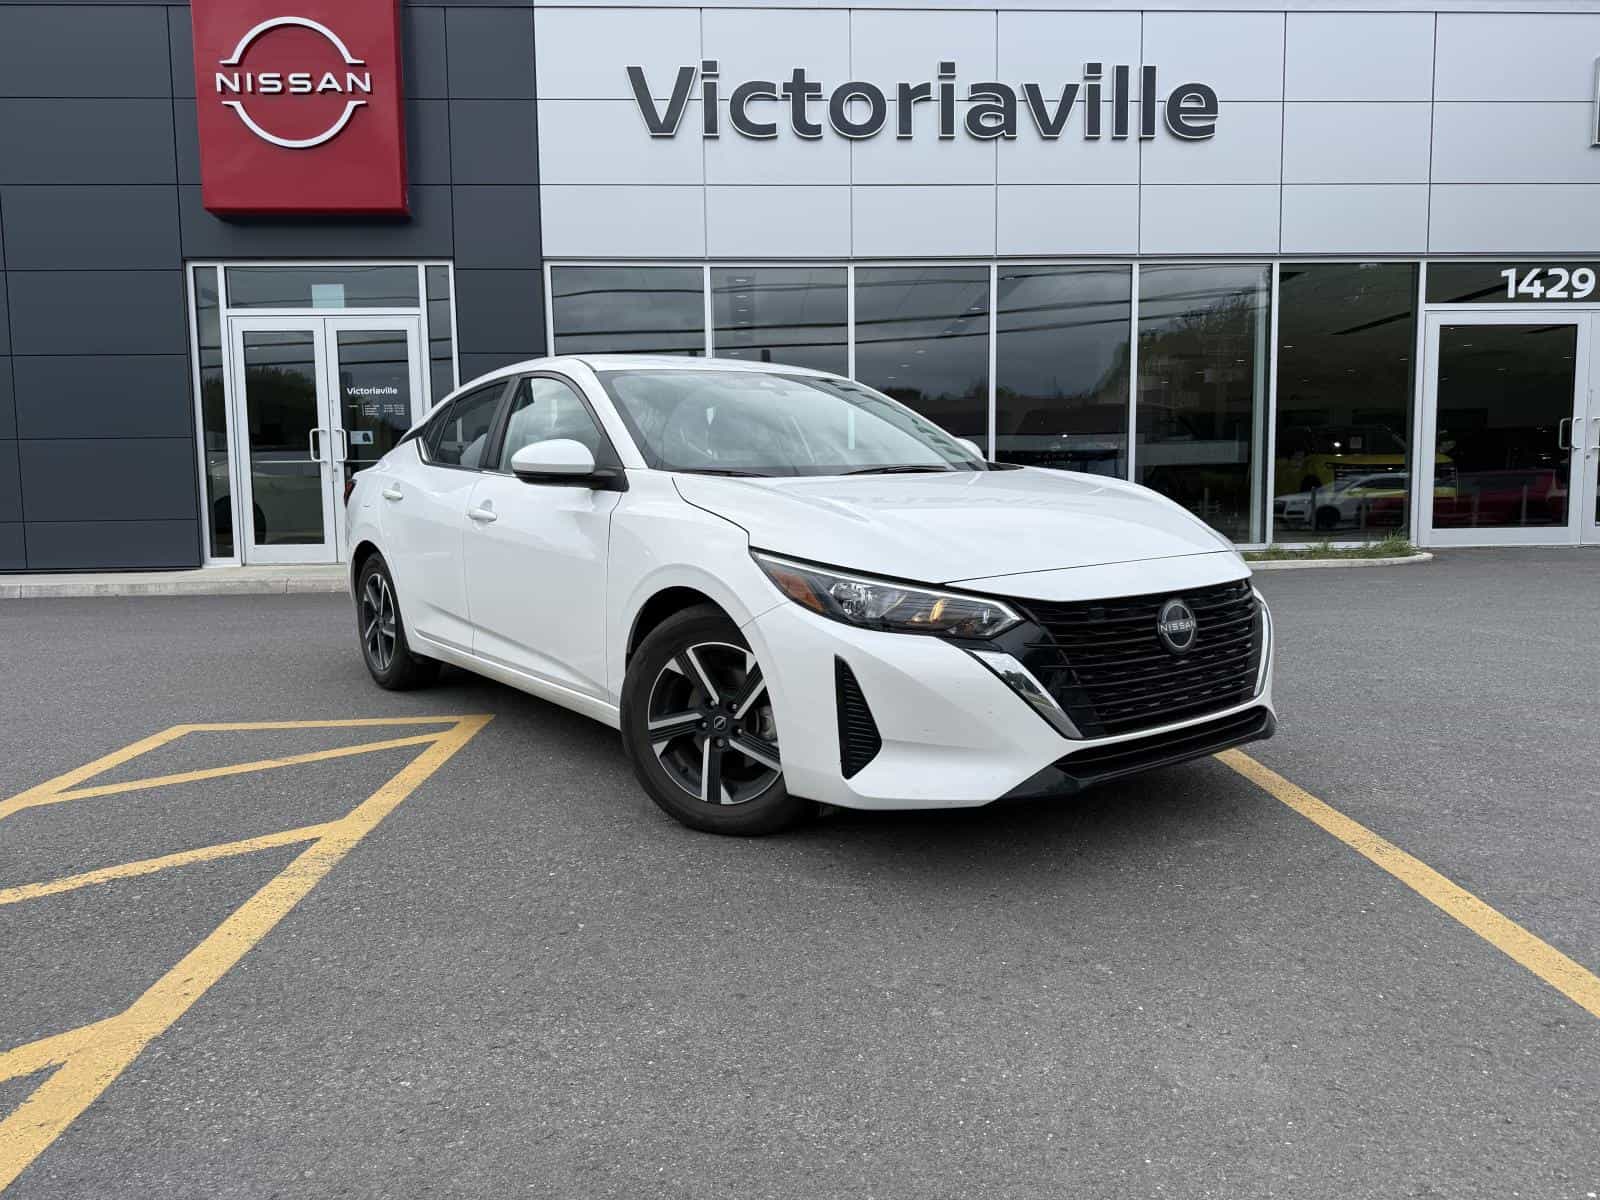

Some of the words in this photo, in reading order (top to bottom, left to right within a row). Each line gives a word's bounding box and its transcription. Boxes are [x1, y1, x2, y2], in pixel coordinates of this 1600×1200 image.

[215, 72, 371, 94] NISSAN
[625, 60, 1220, 140] Victoriaville
[1500, 267, 1596, 299] 1429
[346, 386, 398, 395] Victoriaville
[1160, 619, 1195, 633] NISSAN
